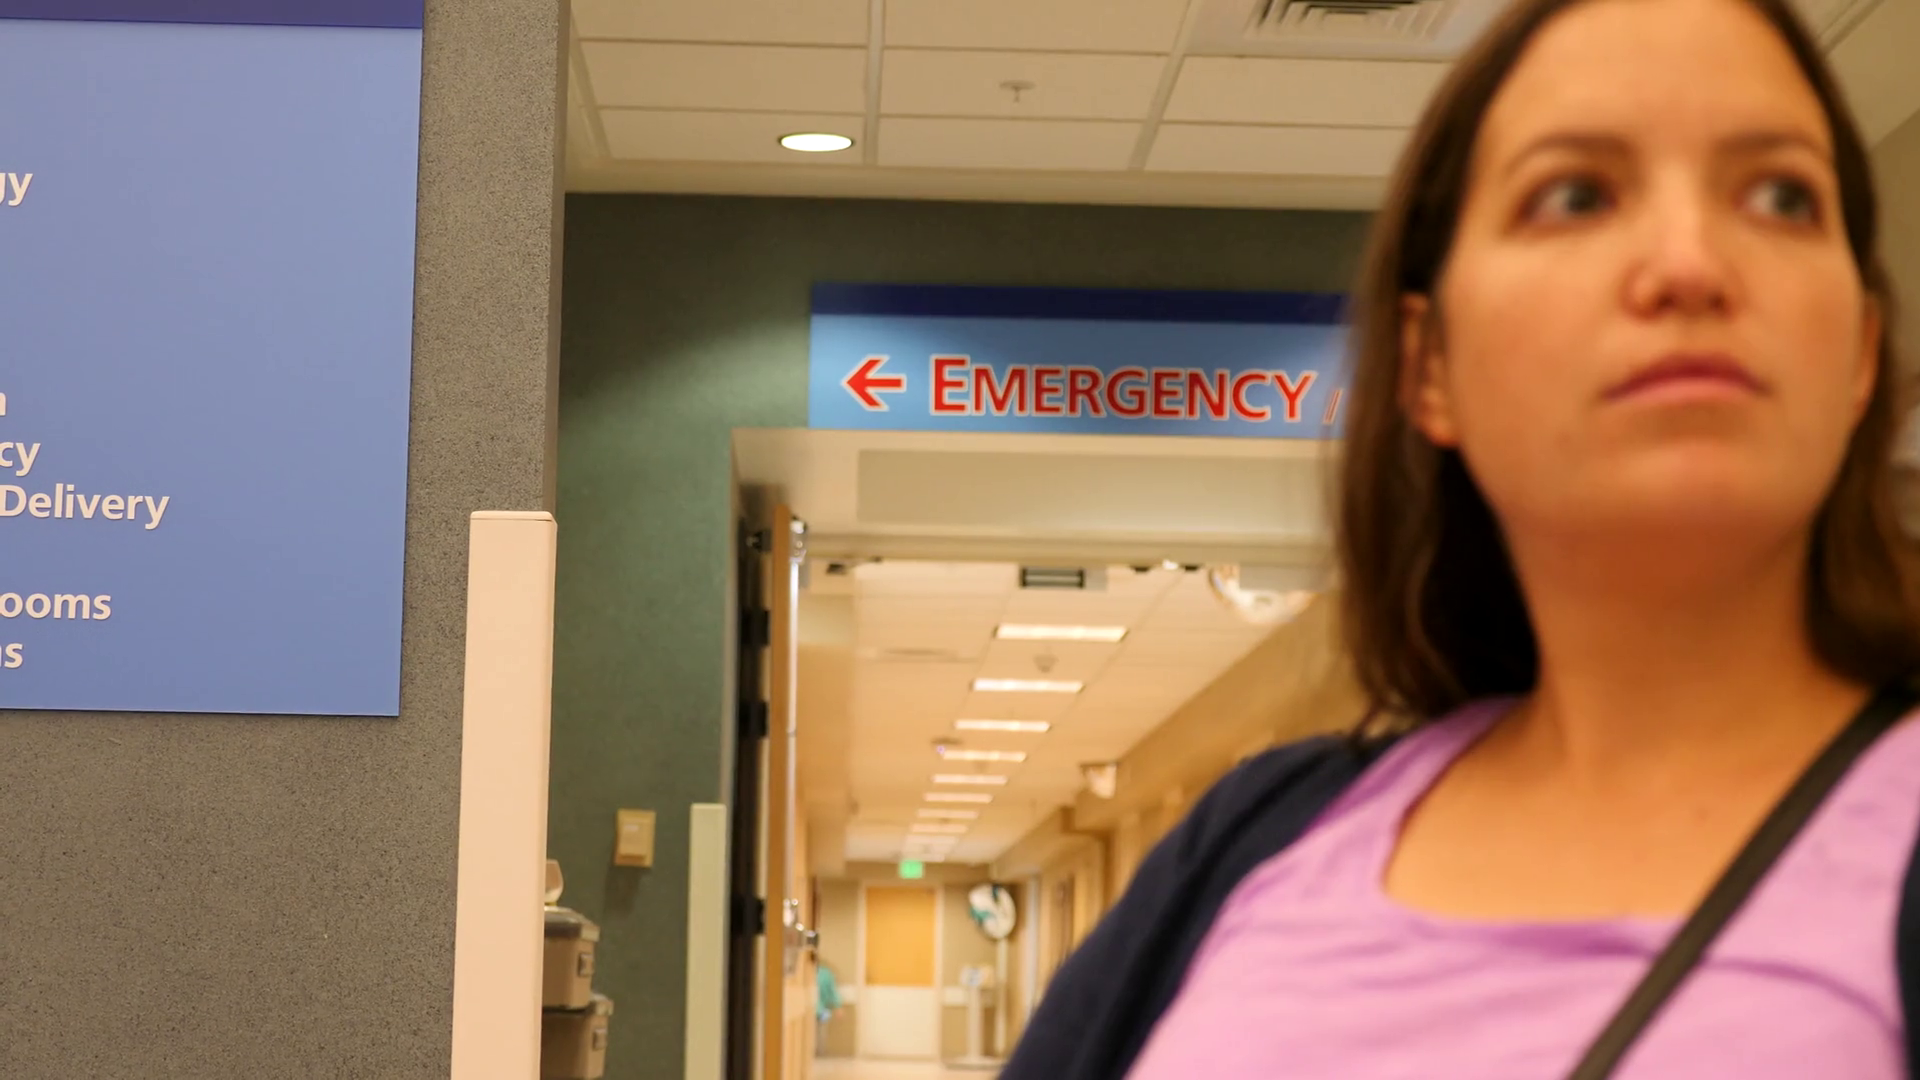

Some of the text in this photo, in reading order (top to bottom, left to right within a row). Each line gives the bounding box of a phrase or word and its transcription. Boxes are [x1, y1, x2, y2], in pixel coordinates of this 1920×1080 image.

[0, 172, 34, 207] y
[930, 354, 1318, 423] EMERGENCY
[0, 483, 170, 529] Delivery
[0, 592, 111, 620] ooms
[0, 642, 24, 668] s
